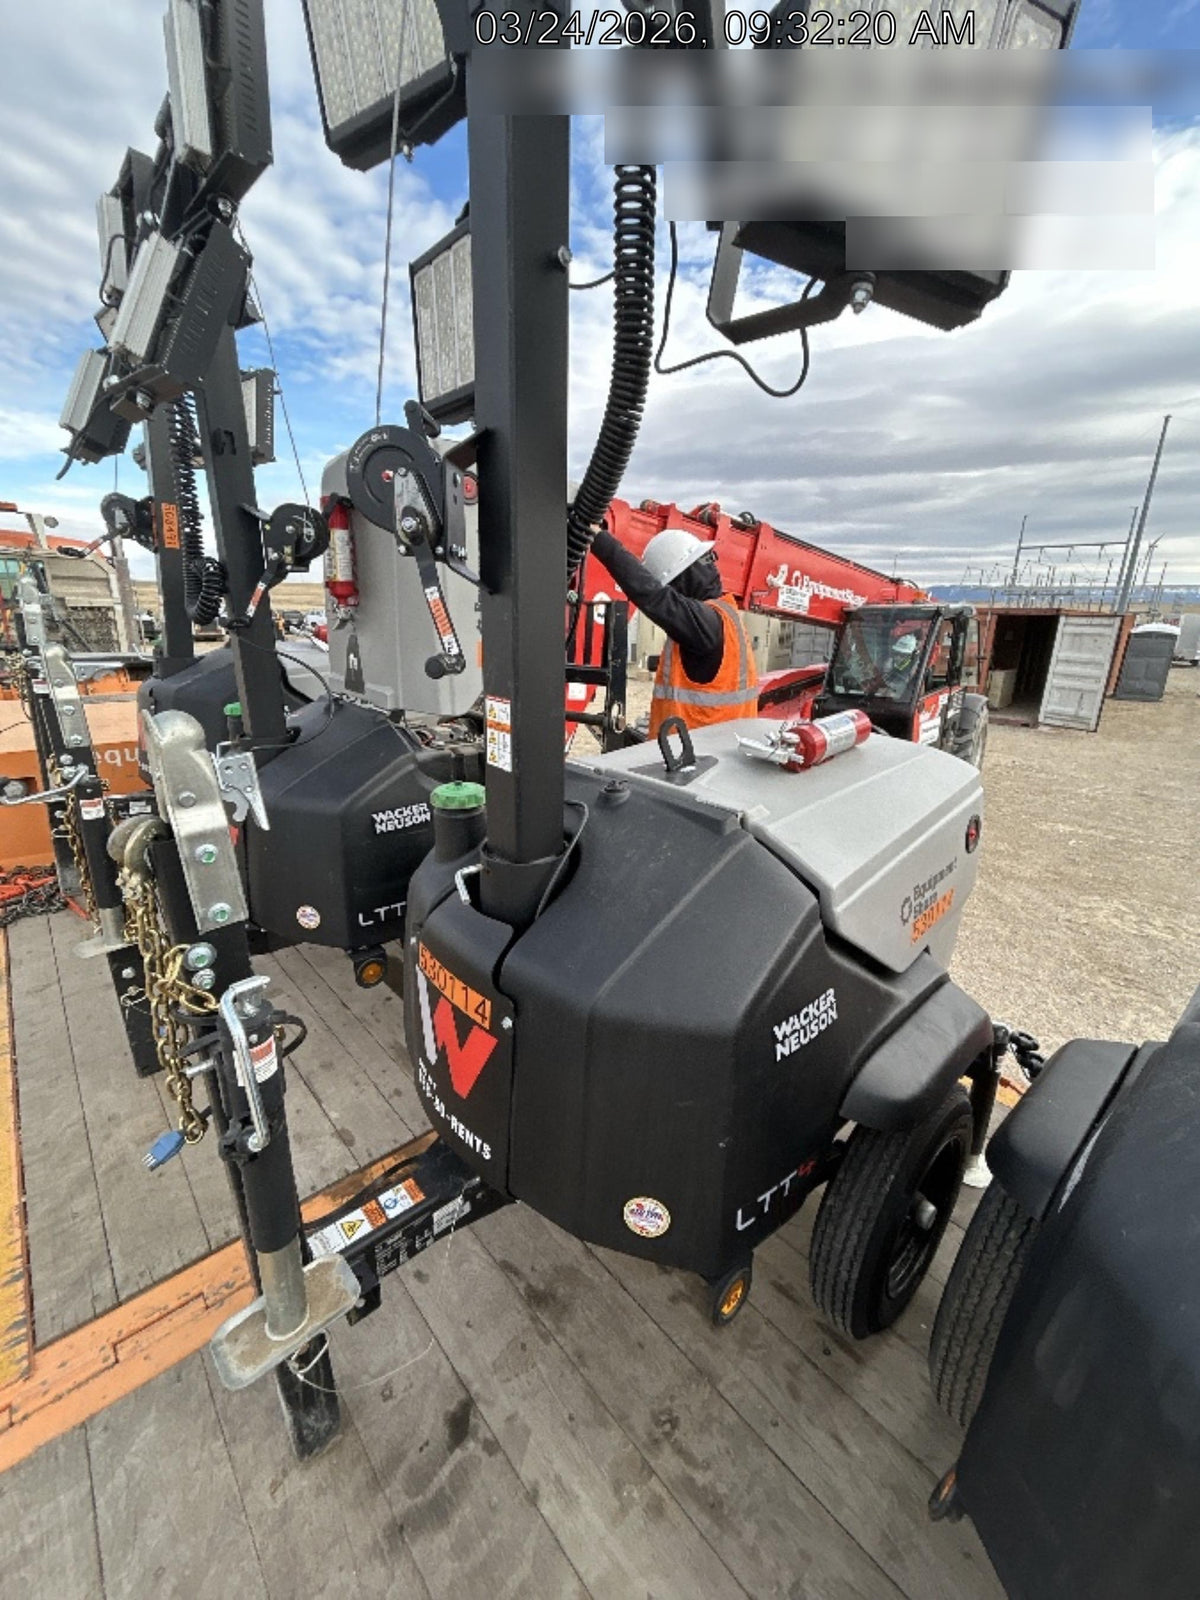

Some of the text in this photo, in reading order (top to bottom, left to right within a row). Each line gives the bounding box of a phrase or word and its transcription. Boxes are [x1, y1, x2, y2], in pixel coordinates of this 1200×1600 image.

[371, 802, 429, 823] WACKER
[374, 811, 431, 834] NEUSON
[420, 946, 488, 1025] 530114
[773, 987, 836, 1041] WACKER
[775, 1003, 838, 1062] NEUSON
